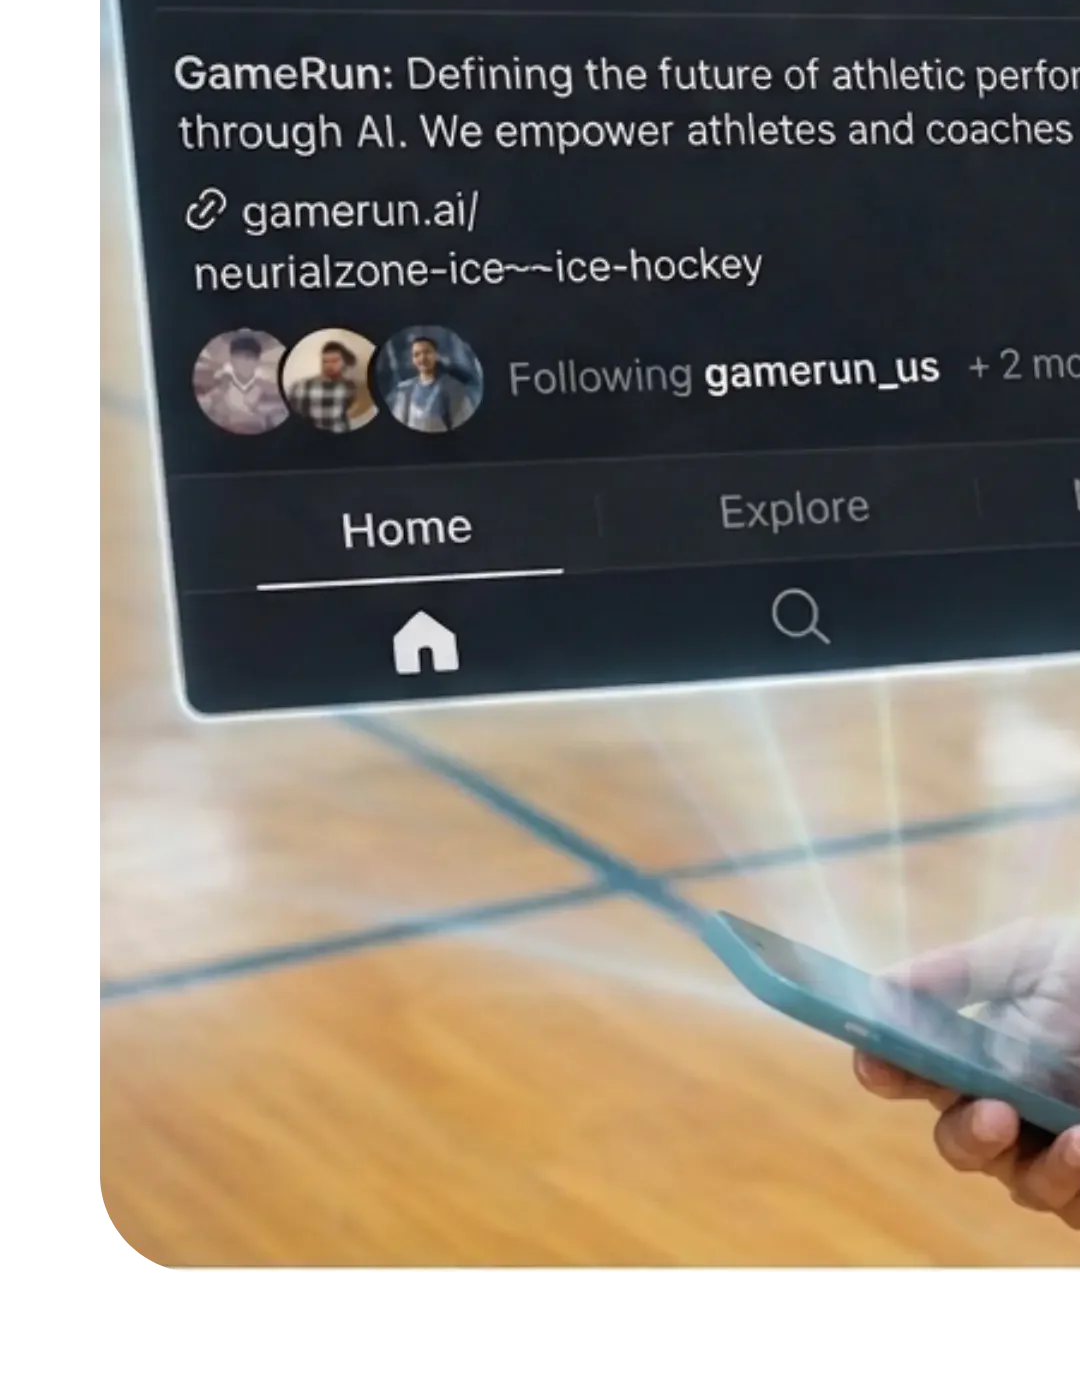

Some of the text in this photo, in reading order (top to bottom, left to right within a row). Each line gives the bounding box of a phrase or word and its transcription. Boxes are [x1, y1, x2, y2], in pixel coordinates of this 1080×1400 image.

[174, 54, 393, 90] GameRun:
[407, 55, 573, 99] Defining
[584, 56, 648, 90] the
[658, 56, 773, 90] future
[784, 56, 820, 90] of
[832, 57, 966, 91] athletic
[178, 113, 342, 157] through
[357, 114, 407, 148] AI.
[419, 114, 483, 148] We
[495, 121, 674, 155] empower
[687, 111, 837, 146] athletes
[848, 111, 914, 145] and
[926, 112, 1074, 145] coaches
[242, 190, 479, 237] gamerun.ai/
[509, 358, 692, 398] Following
[704, 357, 940, 397] gamerun_us
[1000, 347, 1022, 380] 2
[342, 512, 472, 549] Home
[719, 490, 870, 535] Explore
